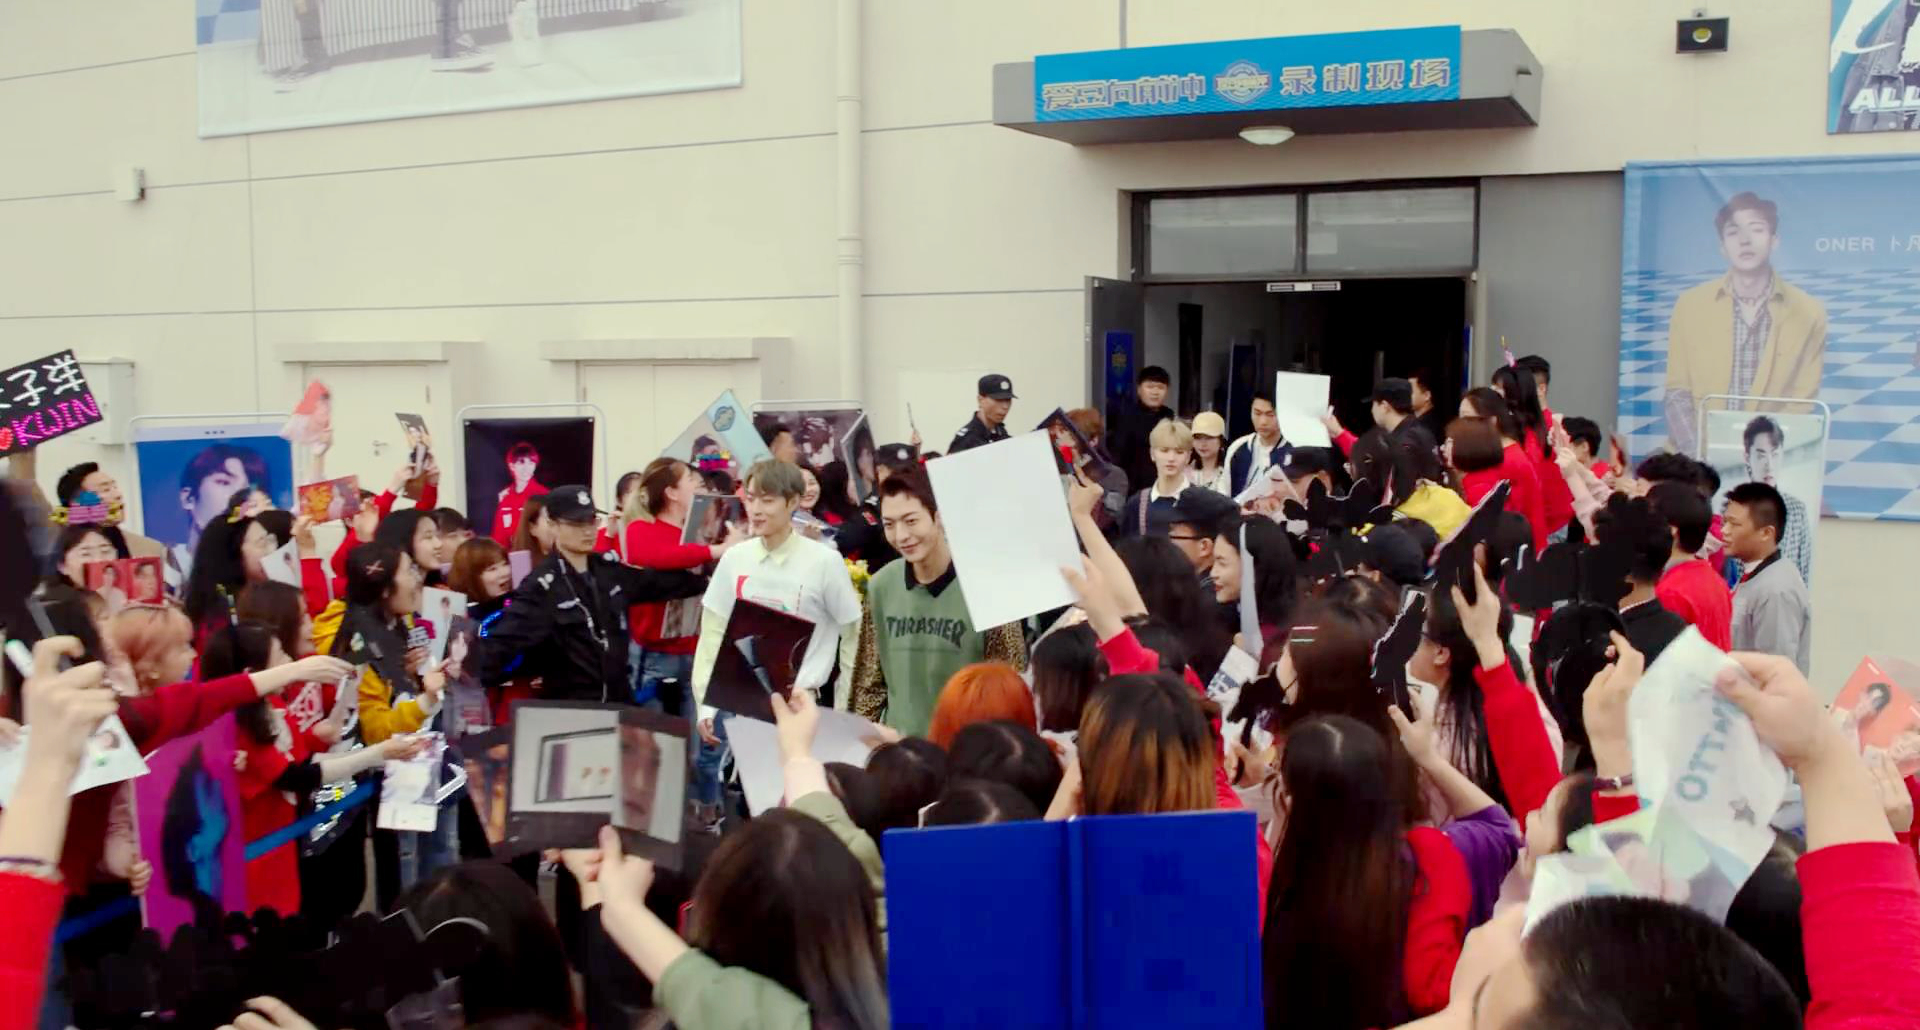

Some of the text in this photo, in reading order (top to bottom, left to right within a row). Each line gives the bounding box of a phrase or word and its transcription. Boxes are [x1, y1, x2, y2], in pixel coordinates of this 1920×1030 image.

[1280, 58, 1450, 96] 录制现场
[1815, 238, 1875, 252] ONER
[886, 616, 967, 649] THRASHER
